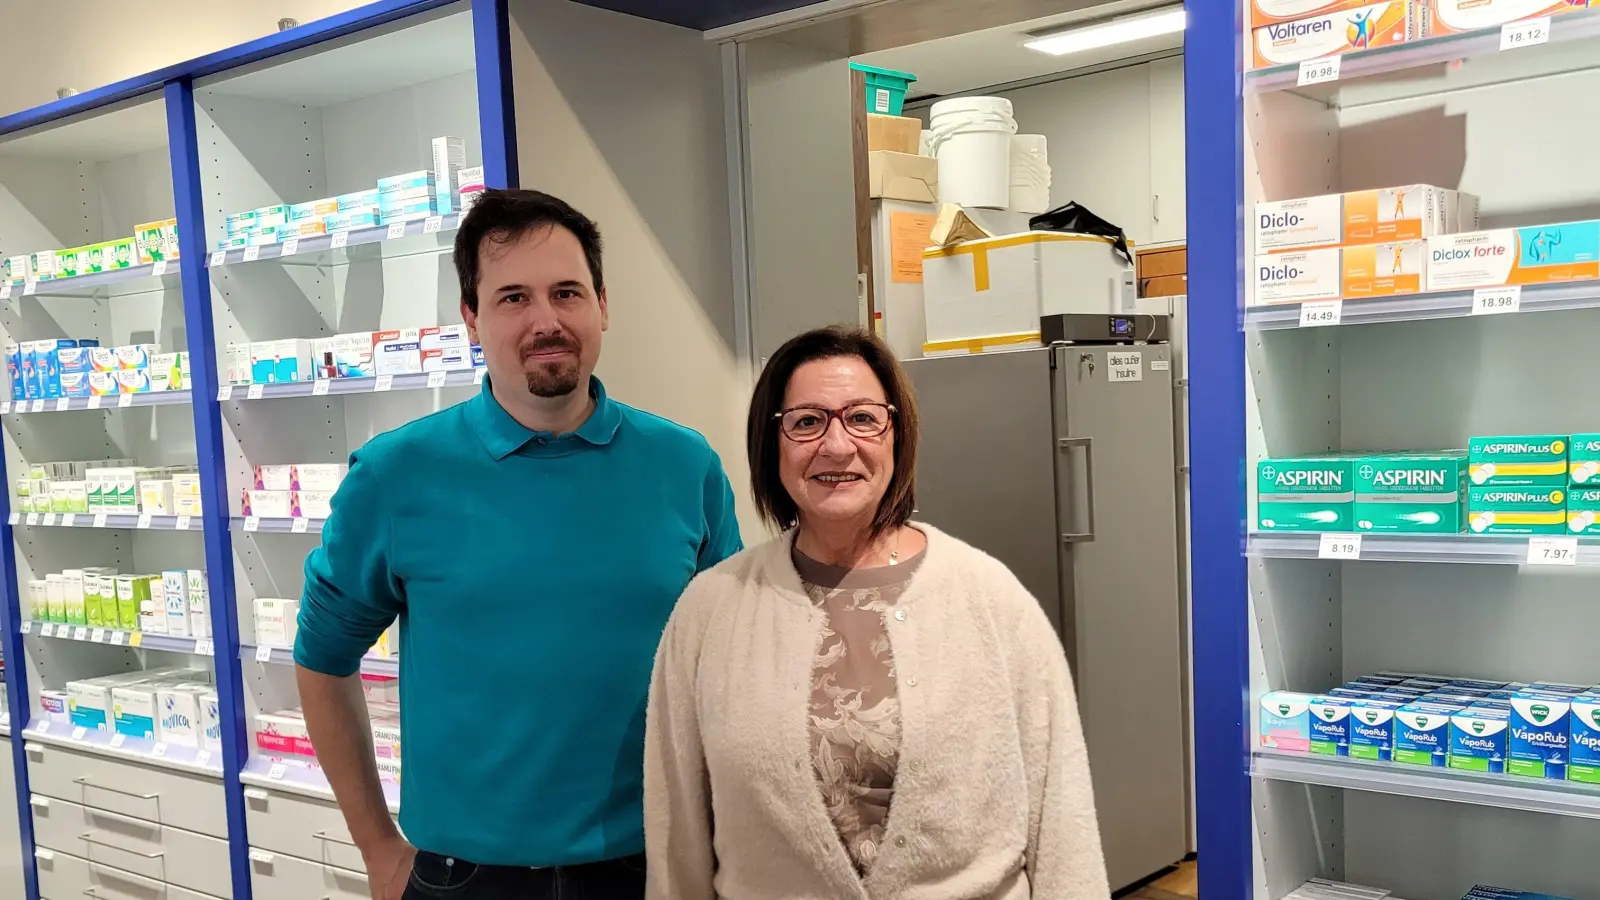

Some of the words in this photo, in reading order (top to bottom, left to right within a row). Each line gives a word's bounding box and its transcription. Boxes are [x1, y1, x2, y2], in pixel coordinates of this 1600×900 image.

[1268, 19, 1332, 41] Voltaren
[1508, 29, 1541, 43] 18.12
[1305, 67, 1333, 79] 10.98
[1260, 212, 1305, 229] Diclo-
[1454, 235, 1489, 245] ratiopharm
[1432, 248, 1471, 262] Diclox
[1473, 245, 1506, 257] forte
[1260, 264, 1304, 281] Diclo-
[1481, 296, 1513, 308] 18.98
[1306, 311, 1333, 322] 14.49
[1482, 443, 1528, 454] ASPIRIN
[1527, 446, 1550, 454] PLUS
[1275, 469, 1343, 486] ASPIRIN
[1372, 469, 1445, 486] ASPIRIN
[1482, 492, 1528, 503] ASPIRIN
[1331, 544, 1354, 553] 8.19
[1543, 549, 1569, 559] 7.97
[162, 714, 192, 730] MOVICOL
[1313, 723, 1345, 735] VapoRub
[1355, 726, 1388, 737] VapoRub
[1403, 731, 1438, 742] VapoRub
[1512, 728, 1567, 743] VapoRub
[1459, 737, 1495, 748] VapoRub
